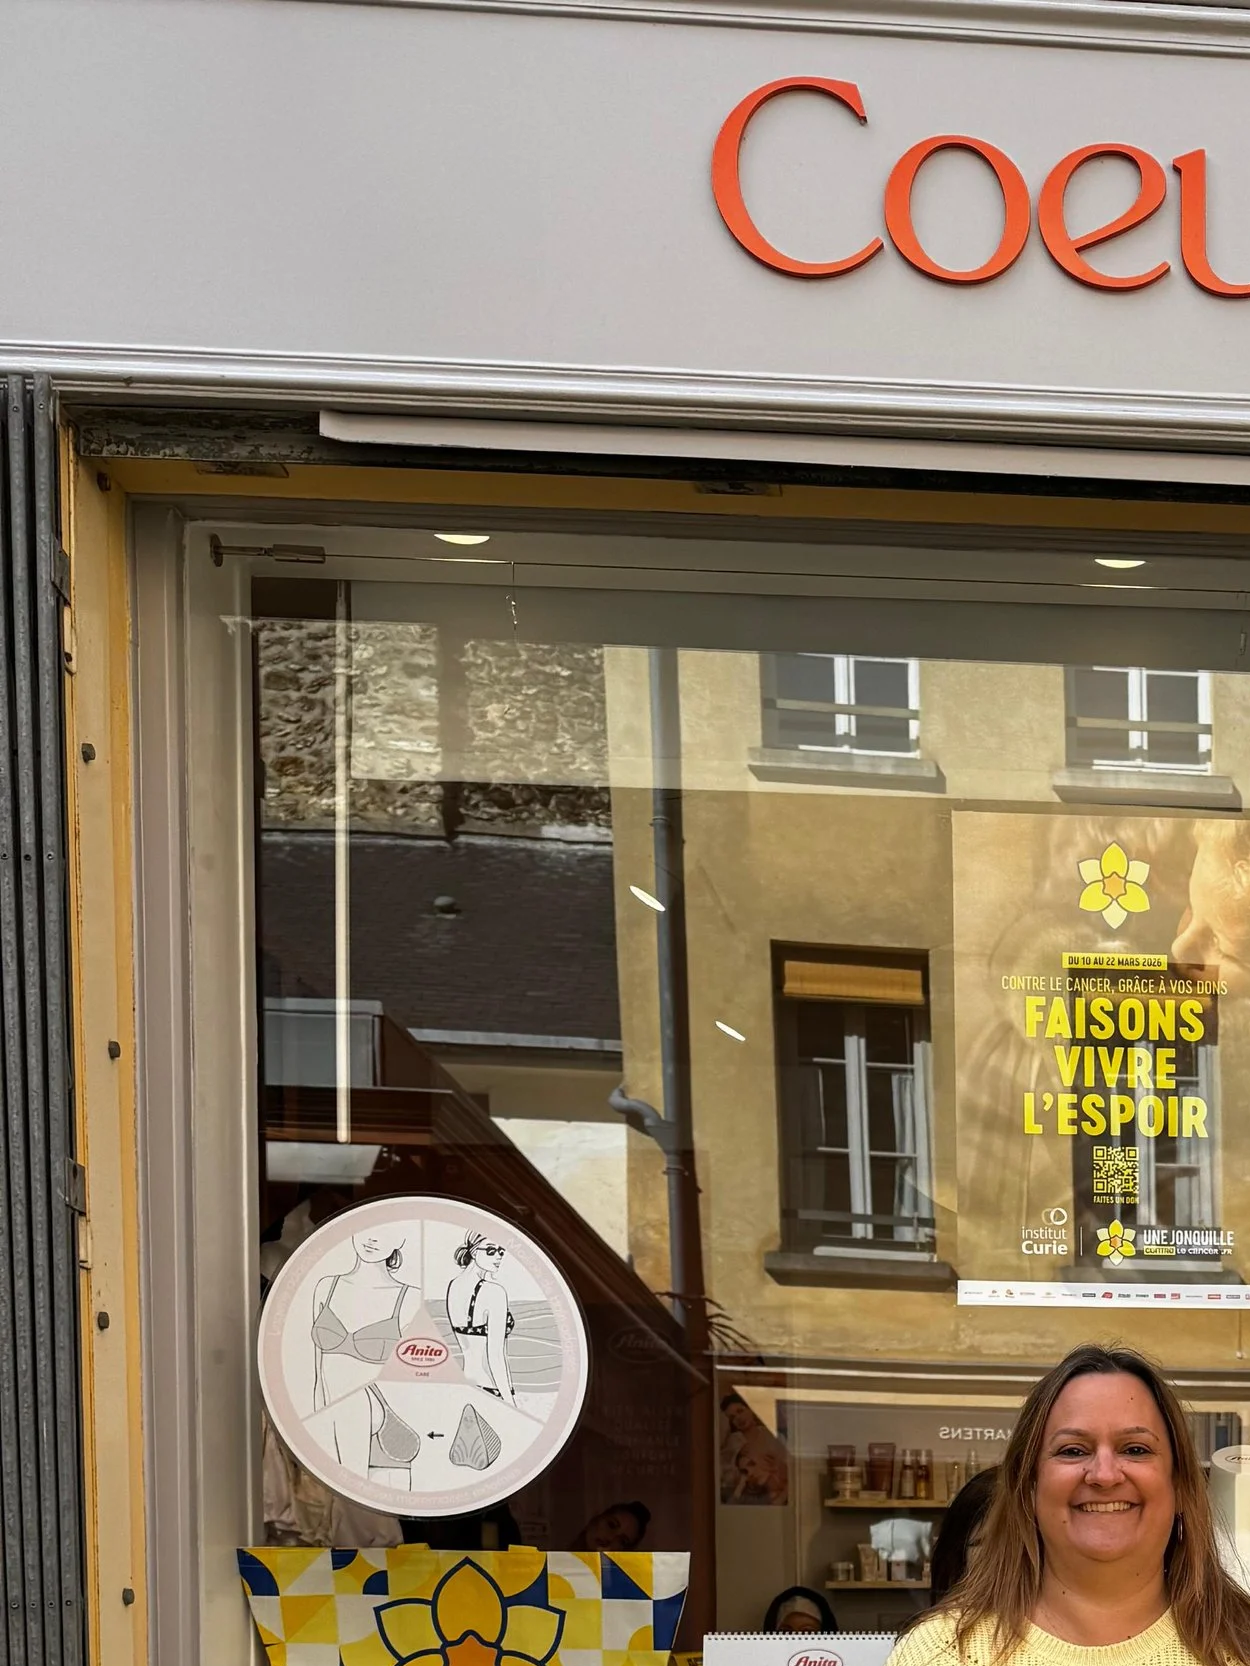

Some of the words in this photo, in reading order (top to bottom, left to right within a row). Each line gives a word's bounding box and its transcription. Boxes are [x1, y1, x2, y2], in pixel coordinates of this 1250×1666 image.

[1068, 956, 1079, 966] DU
[1080, 957, 1091, 966] 10
[1093, 957, 1105, 966] AU
[1106, 957, 1116, 967] 22
[1118, 957, 1140, 967] MARS
[1142, 958, 1162, 968] 2026
[1001, 975, 1046, 991] CONTRE
[1050, 977, 1061, 991] LE
[1066, 977, 1115, 995] CANCER,
[1118, 976, 1154, 994] GRÂCE
[1158, 975, 1167, 994] À
[1170, 979, 1193, 994] VOS
[1196, 980, 1228, 995] DONS
[1025, 995, 1205, 1042] FAISONS
[1054, 1046, 1176, 1089] VIVRE
[1023, 1092, 1208, 1138] L'ESPOIR
[1093, 1196, 1114, 1204] FAITES
[1022, 1225, 1067, 1240] institut
[1143, 1229, 1168, 1245] UNE
[1169, 1230, 1235, 1246] JONQUILLE
[1022, 1241, 1068, 1255] Curie
[402, 1344, 443, 1356] Anita
